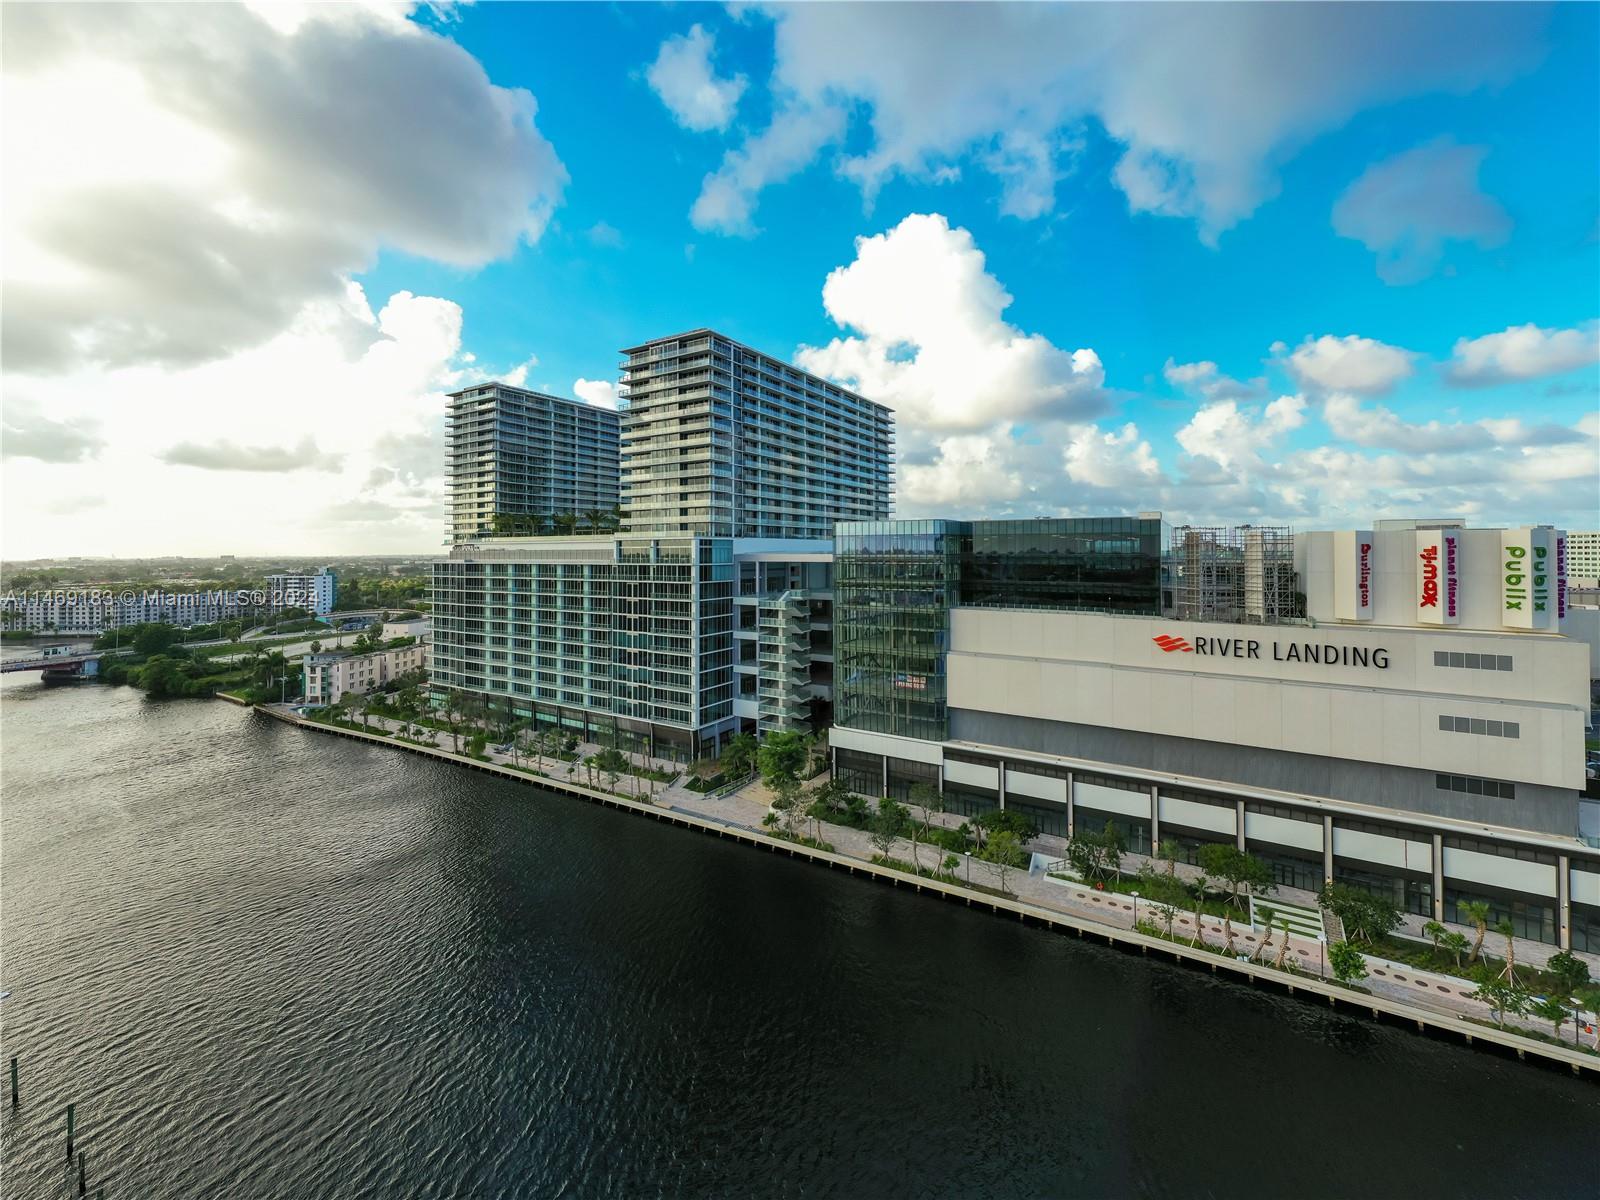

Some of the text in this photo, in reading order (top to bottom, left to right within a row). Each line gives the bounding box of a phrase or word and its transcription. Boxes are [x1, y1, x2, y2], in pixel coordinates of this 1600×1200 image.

[1359, 543, 1371, 607] Burlington
[1445, 537, 1458, 617] planet fitness
[1505, 546, 1526, 610] Publix
[1533, 546, 1548, 611] Publix
[1557, 578, 1567, 618] fitness
[1195, 636, 1389, 669] RIVER LANDING
